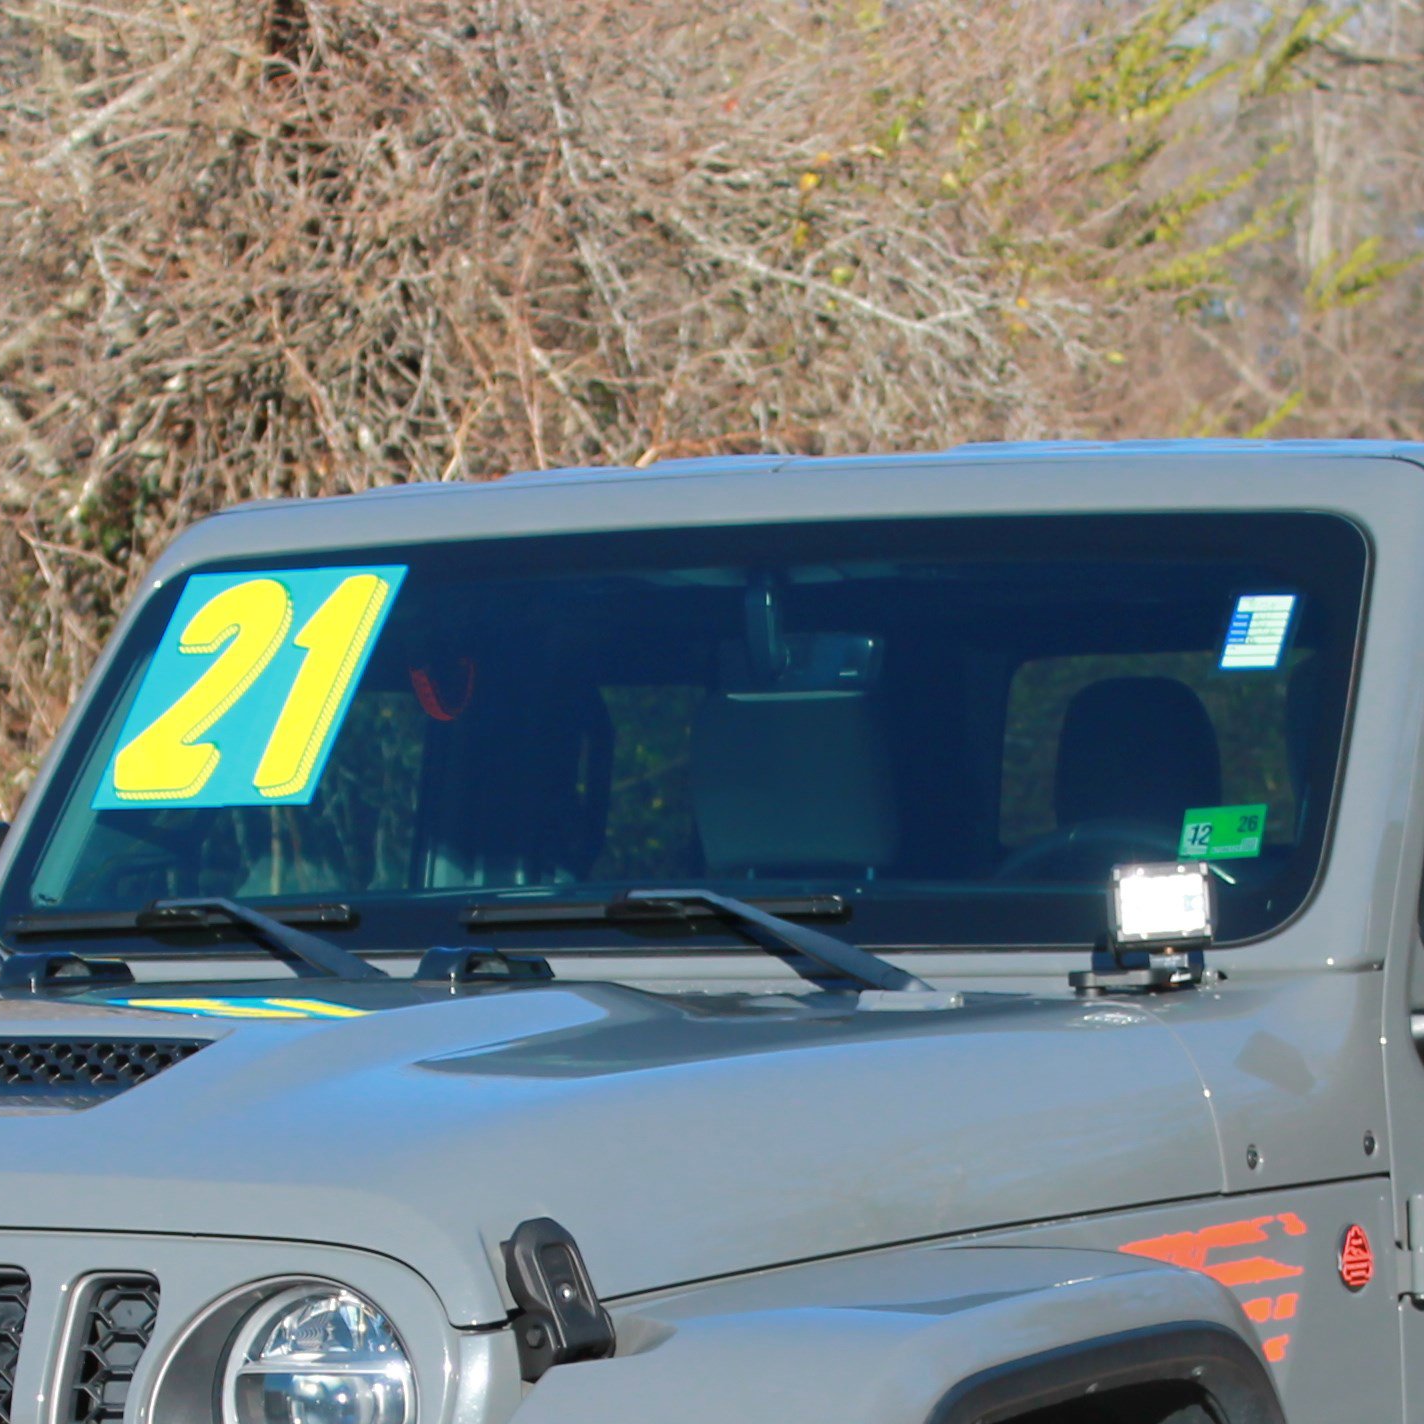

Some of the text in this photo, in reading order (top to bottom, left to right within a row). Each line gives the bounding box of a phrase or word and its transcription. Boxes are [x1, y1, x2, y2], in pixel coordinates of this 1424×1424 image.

[113, 573, 389, 801] 21
[1188, 824, 1213, 847] 12
[1237, 815, 1260, 833] 26
